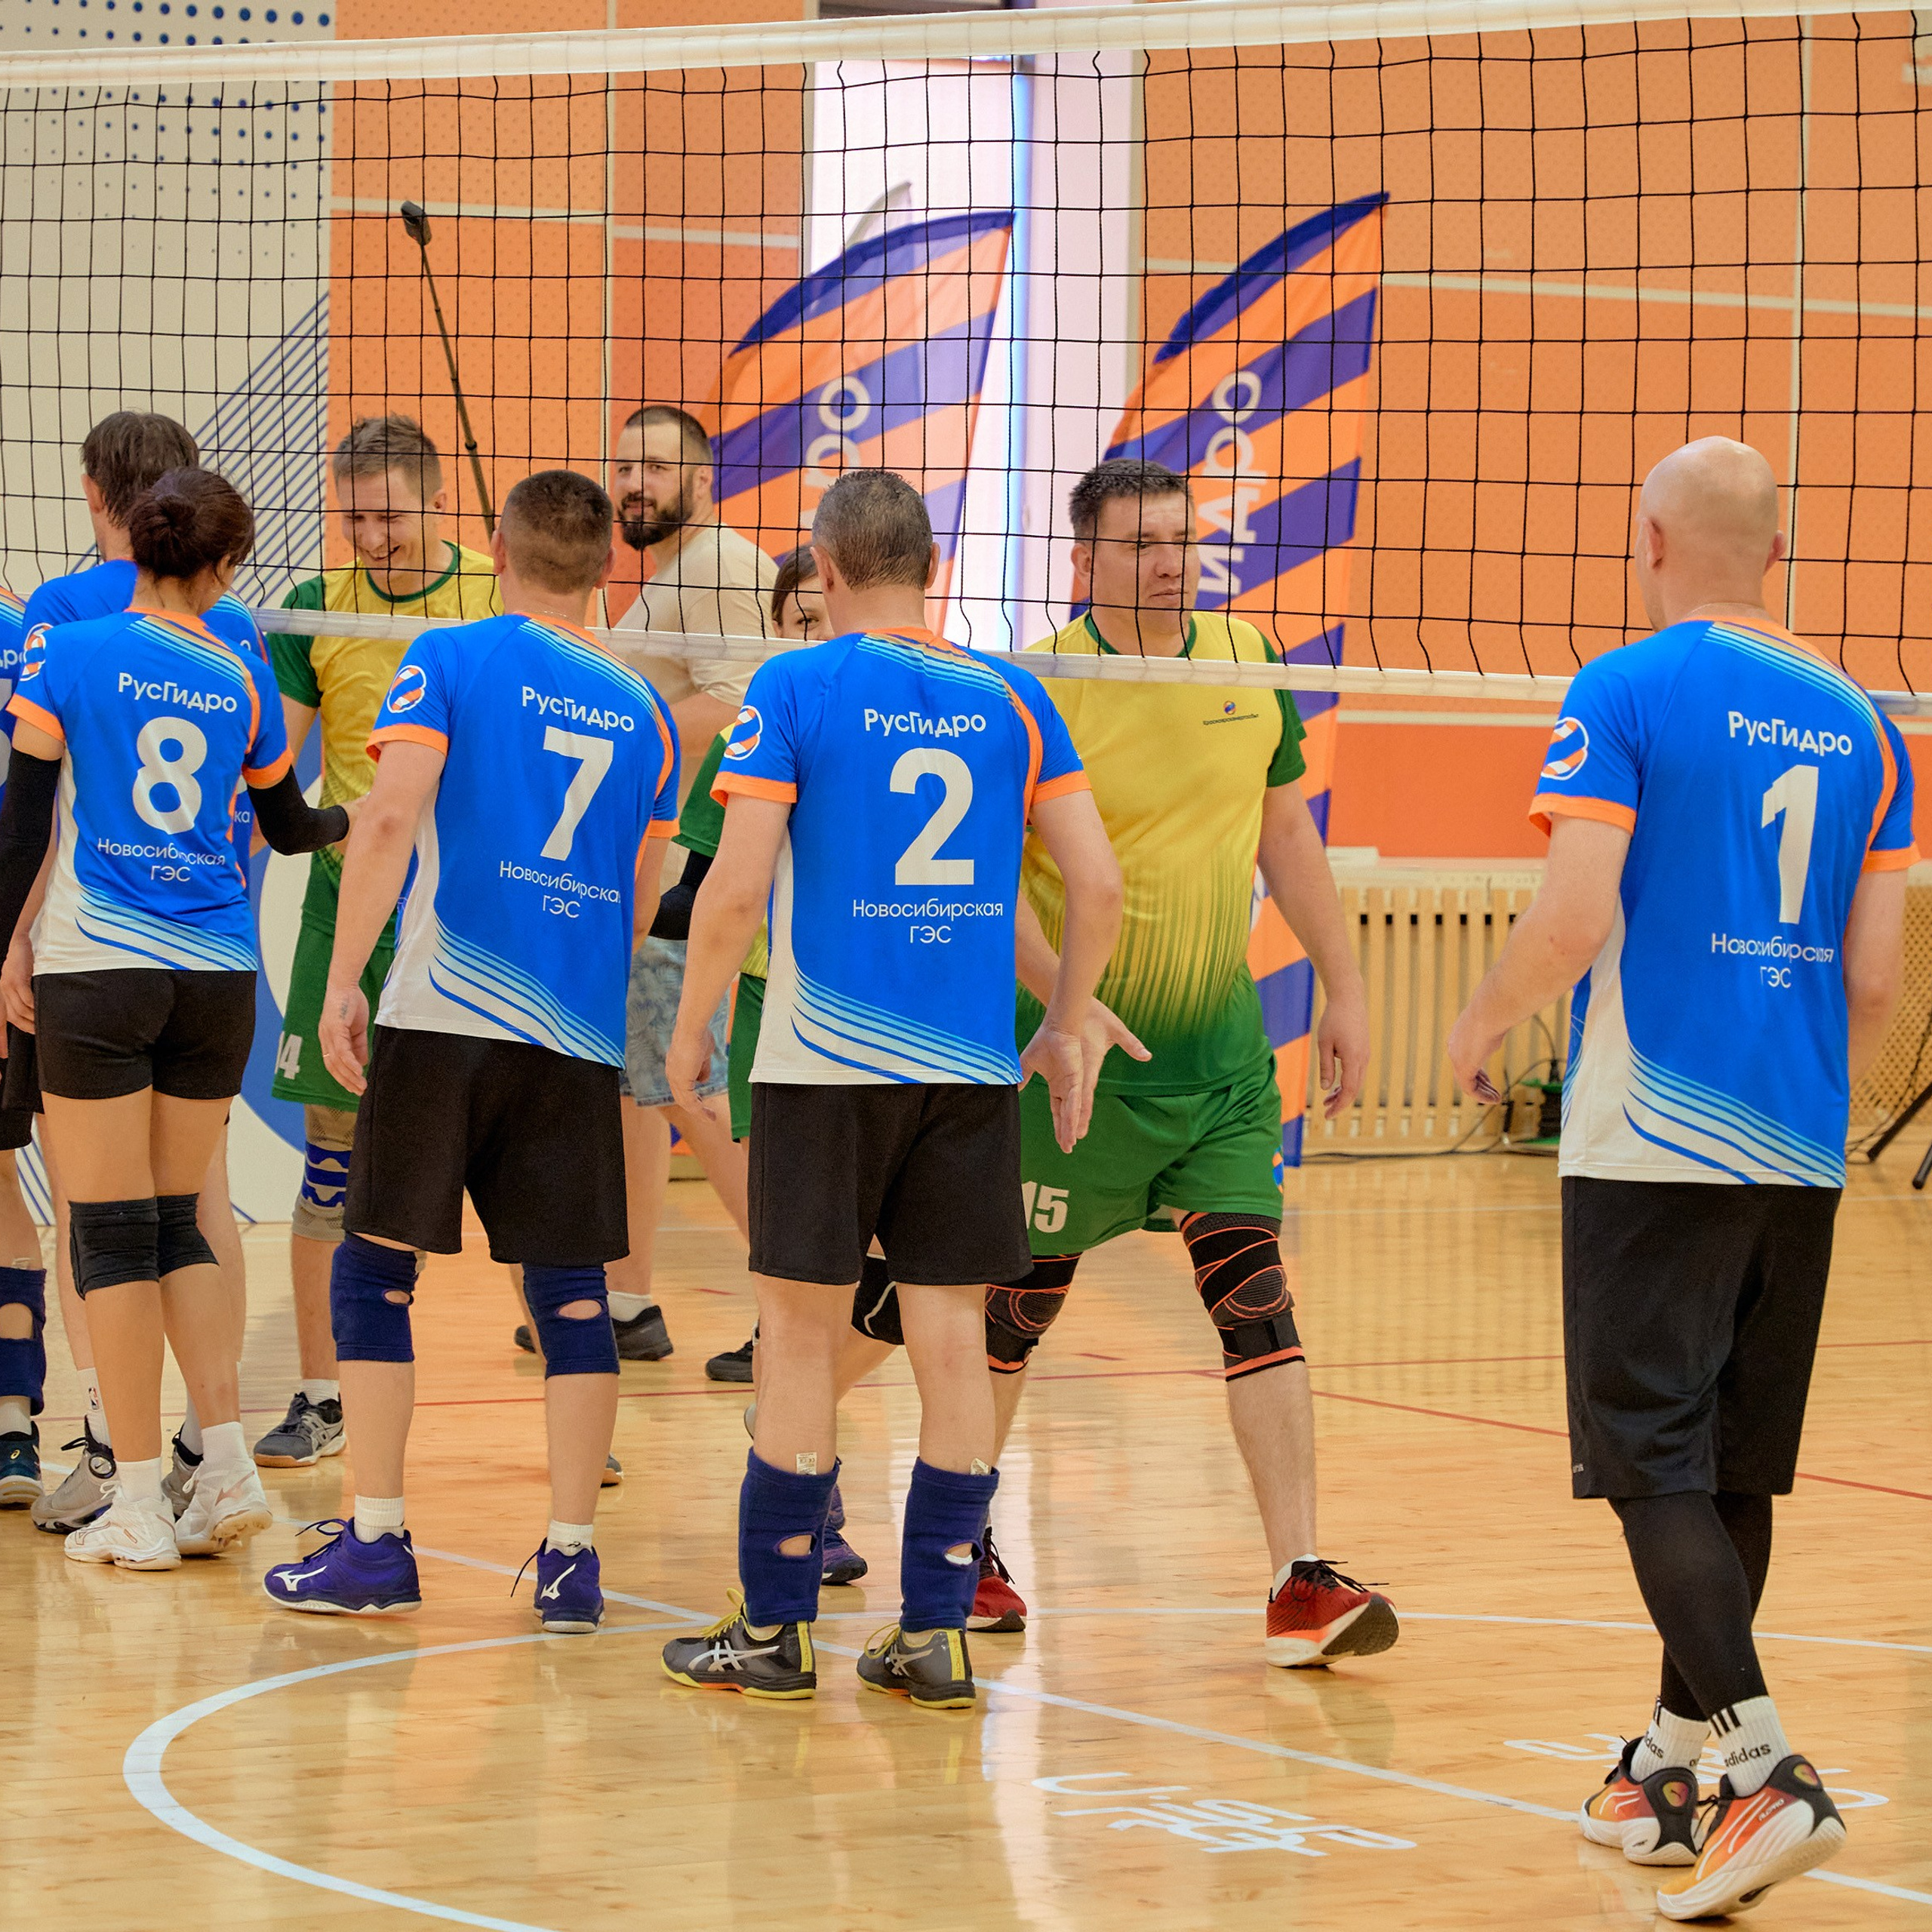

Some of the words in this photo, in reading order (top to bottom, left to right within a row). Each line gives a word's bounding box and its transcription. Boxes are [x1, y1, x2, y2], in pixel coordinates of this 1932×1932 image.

[118, 672, 238, 713] РусГидро
[521, 685, 635, 733] РусГидро
[863, 707, 987, 739] РусГидро
[1727, 710, 1854, 757] РусГидро
[132, 716, 208, 835] 8
[543, 725, 615, 862] 7
[889, 747, 975, 886] 2
[1761, 764, 1820, 924] 1
[149, 865, 192, 883] ГЭС
[499, 860, 621, 905] Новосибирска
[543, 894, 582, 919] ГЭС
[852, 897, 1004, 922] Новосибирская
[909, 925, 952, 944] ГЭС
[1759, 965, 1792, 989] ГЭС
